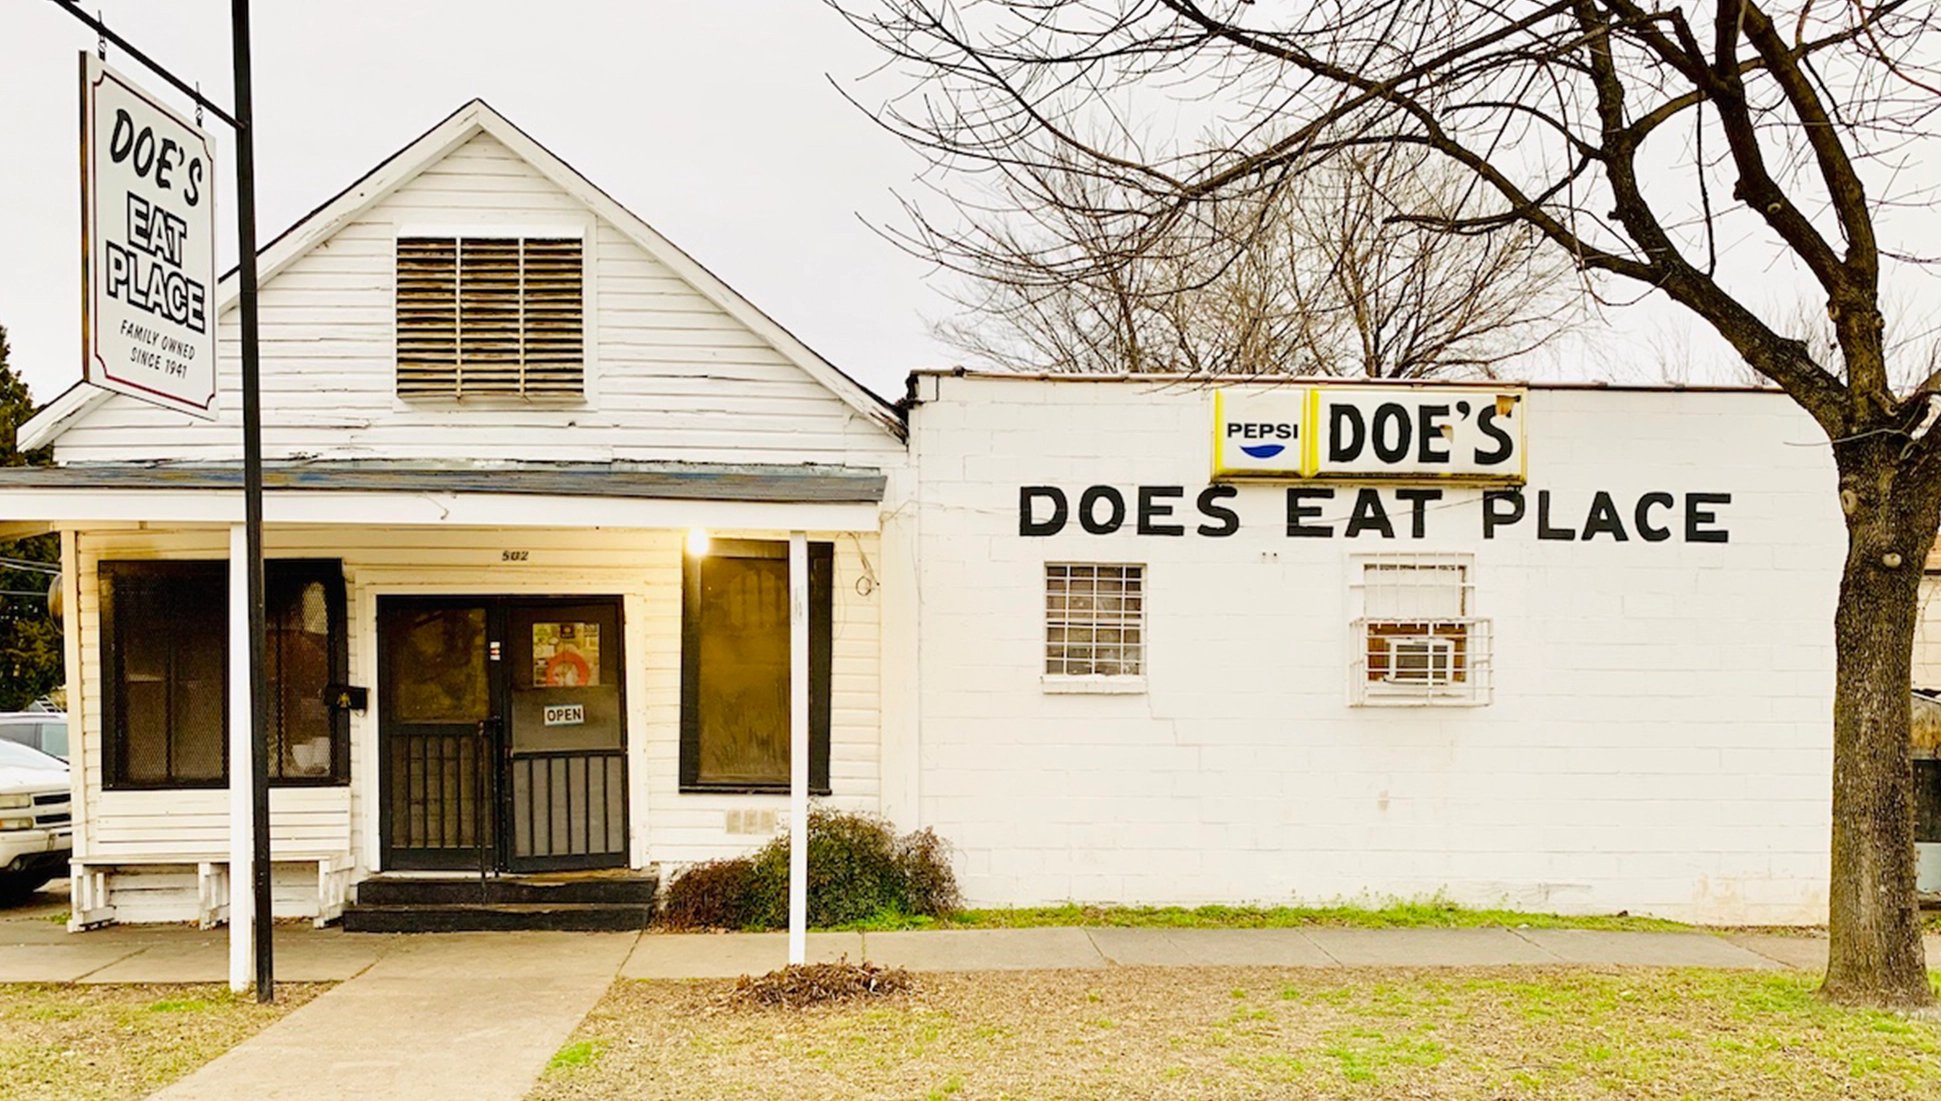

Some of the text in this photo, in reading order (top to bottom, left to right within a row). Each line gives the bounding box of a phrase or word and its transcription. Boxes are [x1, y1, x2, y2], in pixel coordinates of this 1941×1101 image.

[110, 108, 202, 206] DOE'S
[127, 190, 187, 268] EAT
[106, 240, 205, 335] PLACE
[120, 319, 195, 361] FAMILY OWNED
[130, 346, 187, 379] SINCE 1941
[1227, 423, 1298, 439] PEPSI
[1329, 401, 1516, 465] DOE'S
[1019, 485, 1732, 543] DOES EAT PLACE
[502, 550, 529, 562] 502
[547, 708, 581, 722] OPEN
